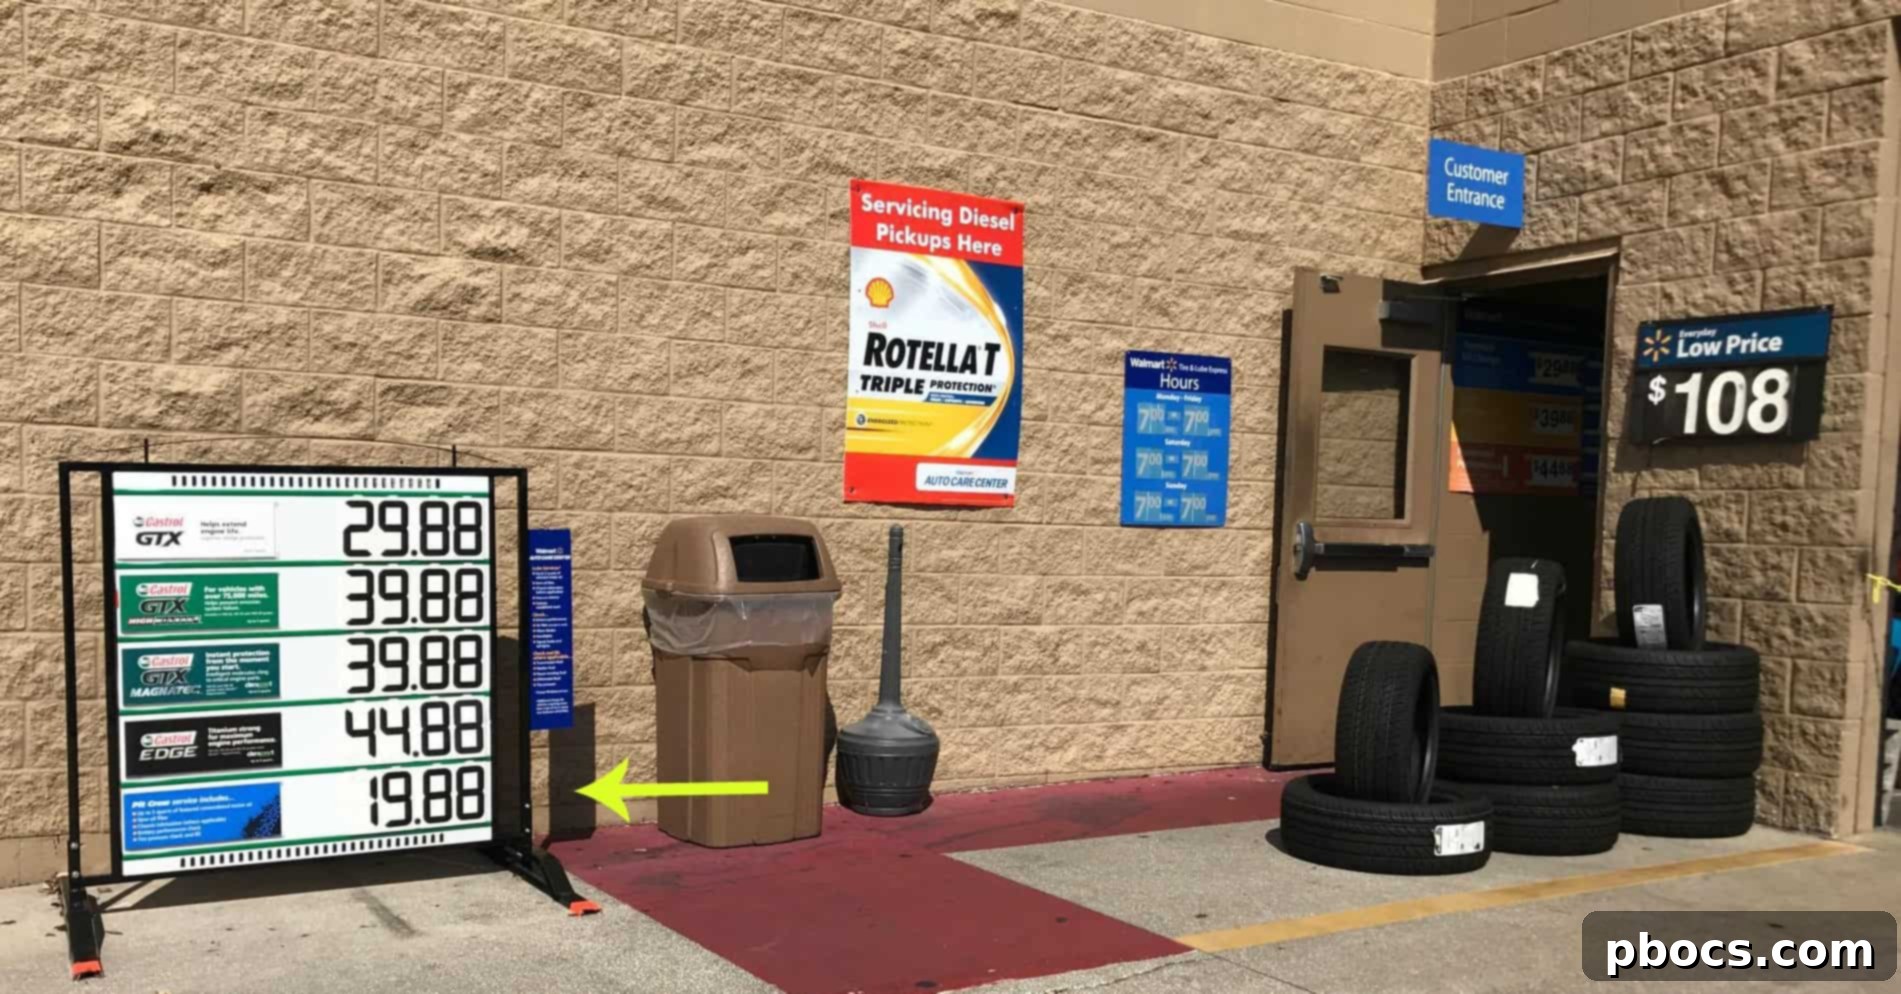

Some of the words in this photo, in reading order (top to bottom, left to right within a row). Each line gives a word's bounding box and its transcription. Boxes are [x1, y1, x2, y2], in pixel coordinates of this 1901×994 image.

[1444, 157, 1509, 185] Customer
[1447, 182, 1504, 210] Entrance
[861, 193, 952, 227] Servicing
[959, 206, 1015, 231] Diesel
[876, 223, 951, 253] Pickups
[957, 234, 1002, 256] Here
[1676, 338, 1722, 359] Low
[1725, 332, 1783, 354] Price
[1679, 328, 1717, 339] Everyday
[863, 332, 978, 375] ROTELLA
[984, 343, 1001, 376] T
[1130, 357, 1165, 370] Walmart
[860, 374, 925, 395] TRIPLE
[930, 380, 993, 393] PROTECTION
[1160, 372, 1200, 390] Hours
[1674, 368, 1790, 435] 108
[144, 516, 184, 527] Castrol
[343, 500, 482, 557] 29.88
[135, 531, 185, 547] GTX
[149, 584, 187, 595] Castrol
[346, 568, 484, 626] 39.88
[140, 597, 190, 614] GTX
[151, 655, 190, 667] Castrol
[347, 634, 483, 694] 39.88
[140, 668, 192, 685] GTX
[154, 734, 192, 745] Castrol
[345, 699, 484, 758] 44.88
[139, 746, 198, 761] EDGE
[370, 765, 485, 828] 19.88
